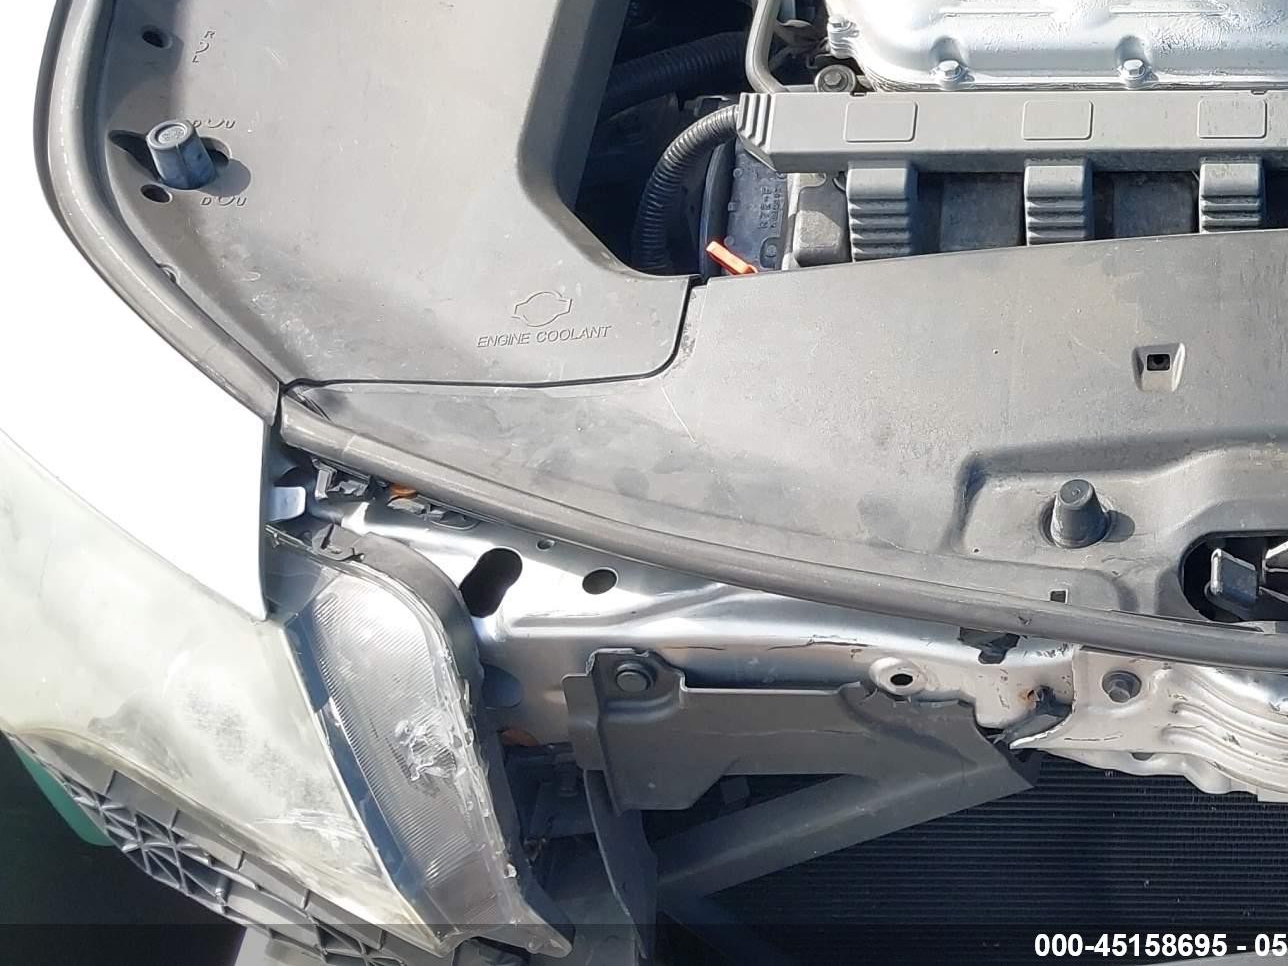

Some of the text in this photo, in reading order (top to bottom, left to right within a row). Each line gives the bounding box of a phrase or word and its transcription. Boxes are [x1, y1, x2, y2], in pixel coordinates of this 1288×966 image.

[203, 29, 215, 39] R
[191, 55, 201, 64] L
[201, 196, 212, 206] D
[476, 325, 612, 348] ENGINE COOLANT
